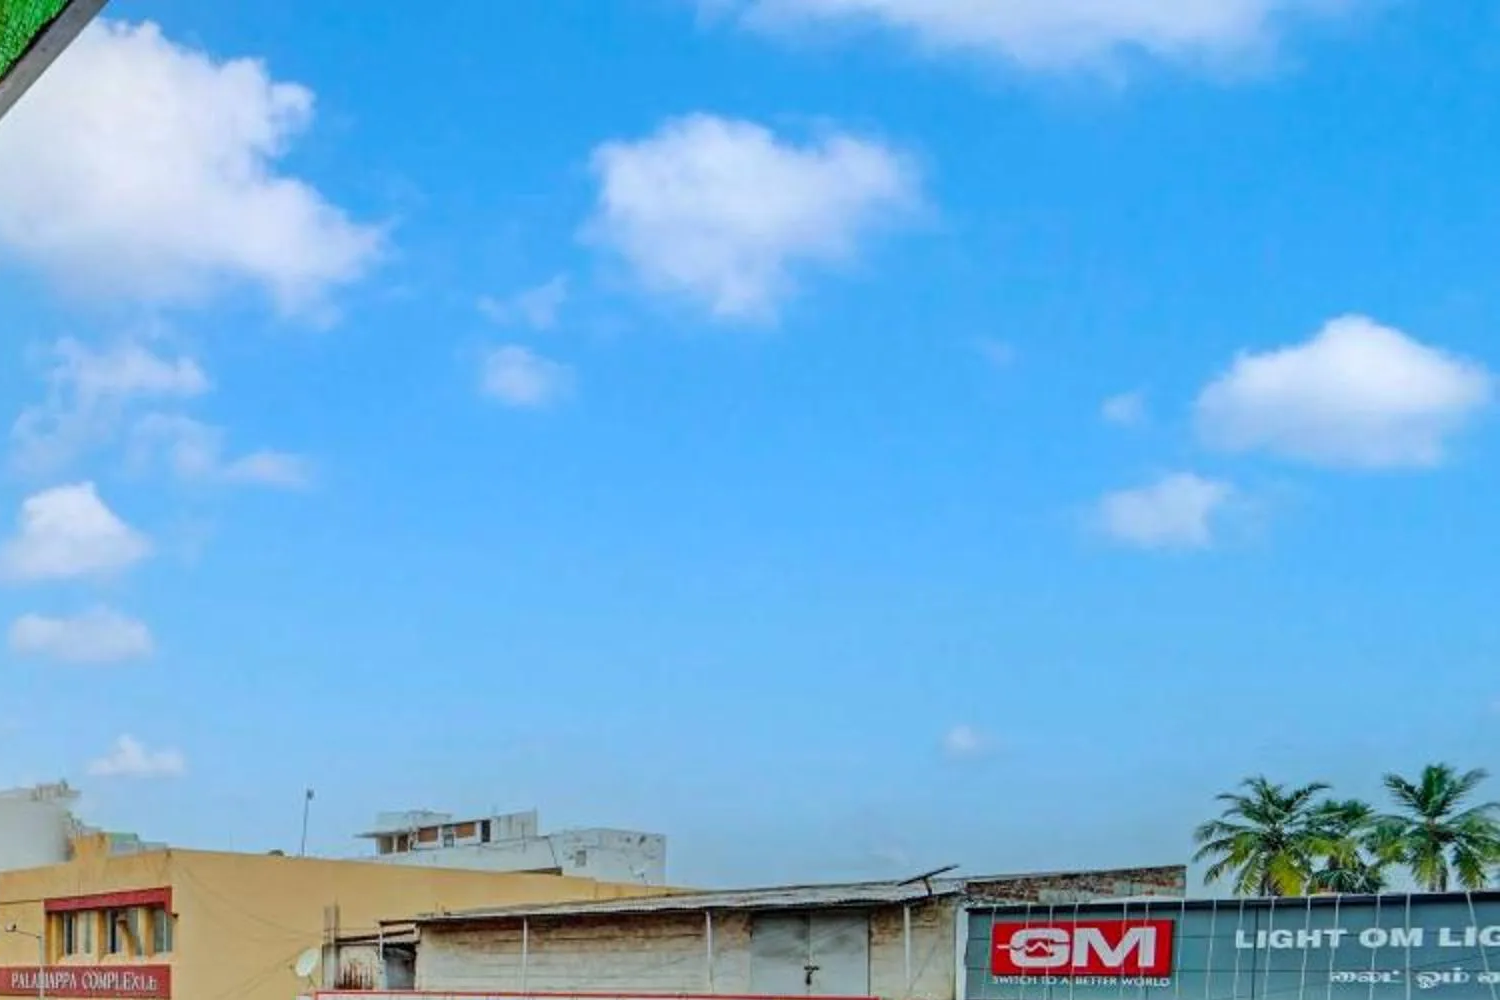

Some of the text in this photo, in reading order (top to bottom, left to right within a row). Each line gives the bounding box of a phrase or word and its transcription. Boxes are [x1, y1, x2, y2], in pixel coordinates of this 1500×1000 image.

[998, 926, 1157, 968] GM
[1235, 929, 1348, 949] LIGHT
[1359, 927, 1424, 948] OM
[1121, 977, 1171, 987] WORLD
